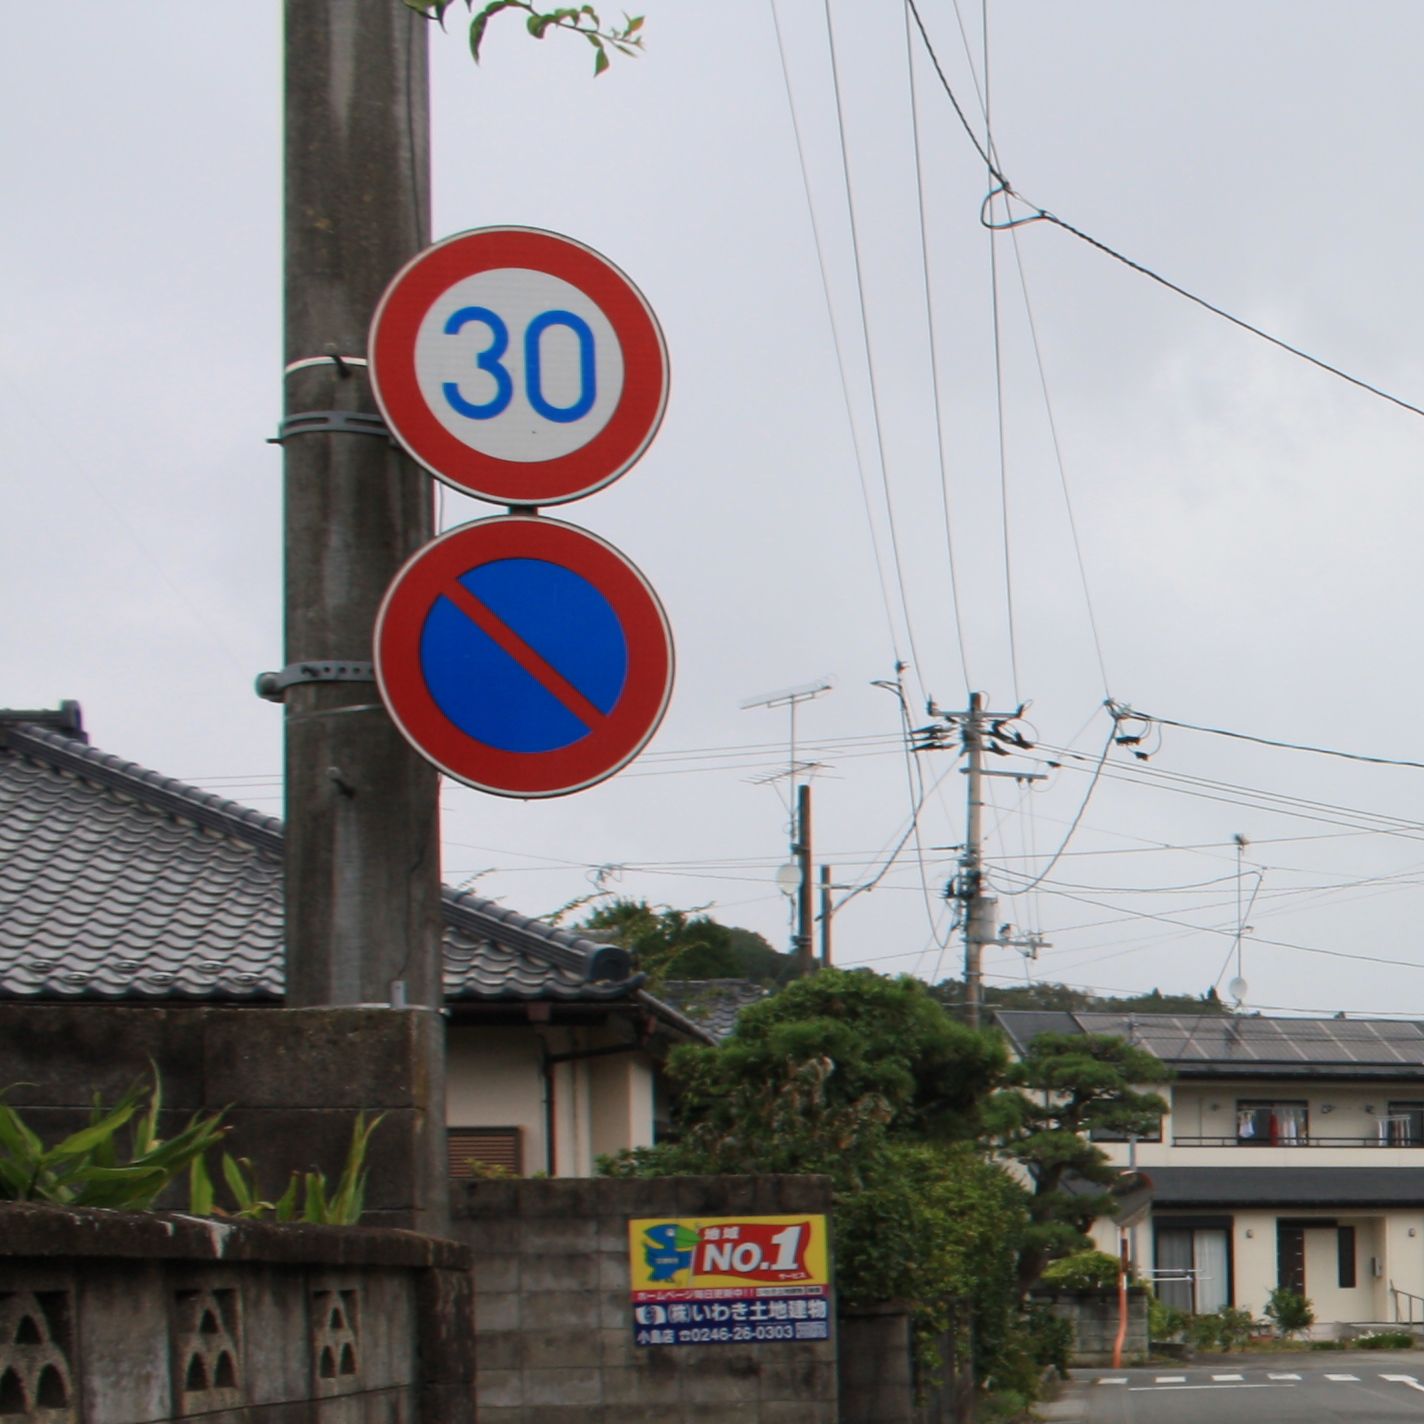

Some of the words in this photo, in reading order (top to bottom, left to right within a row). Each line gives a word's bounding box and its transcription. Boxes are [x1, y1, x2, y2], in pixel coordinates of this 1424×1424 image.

[441, 306, 597, 423] 30
[702, 1225, 802, 1272] NO.1
[703, 1226, 740, 1240] 地域
